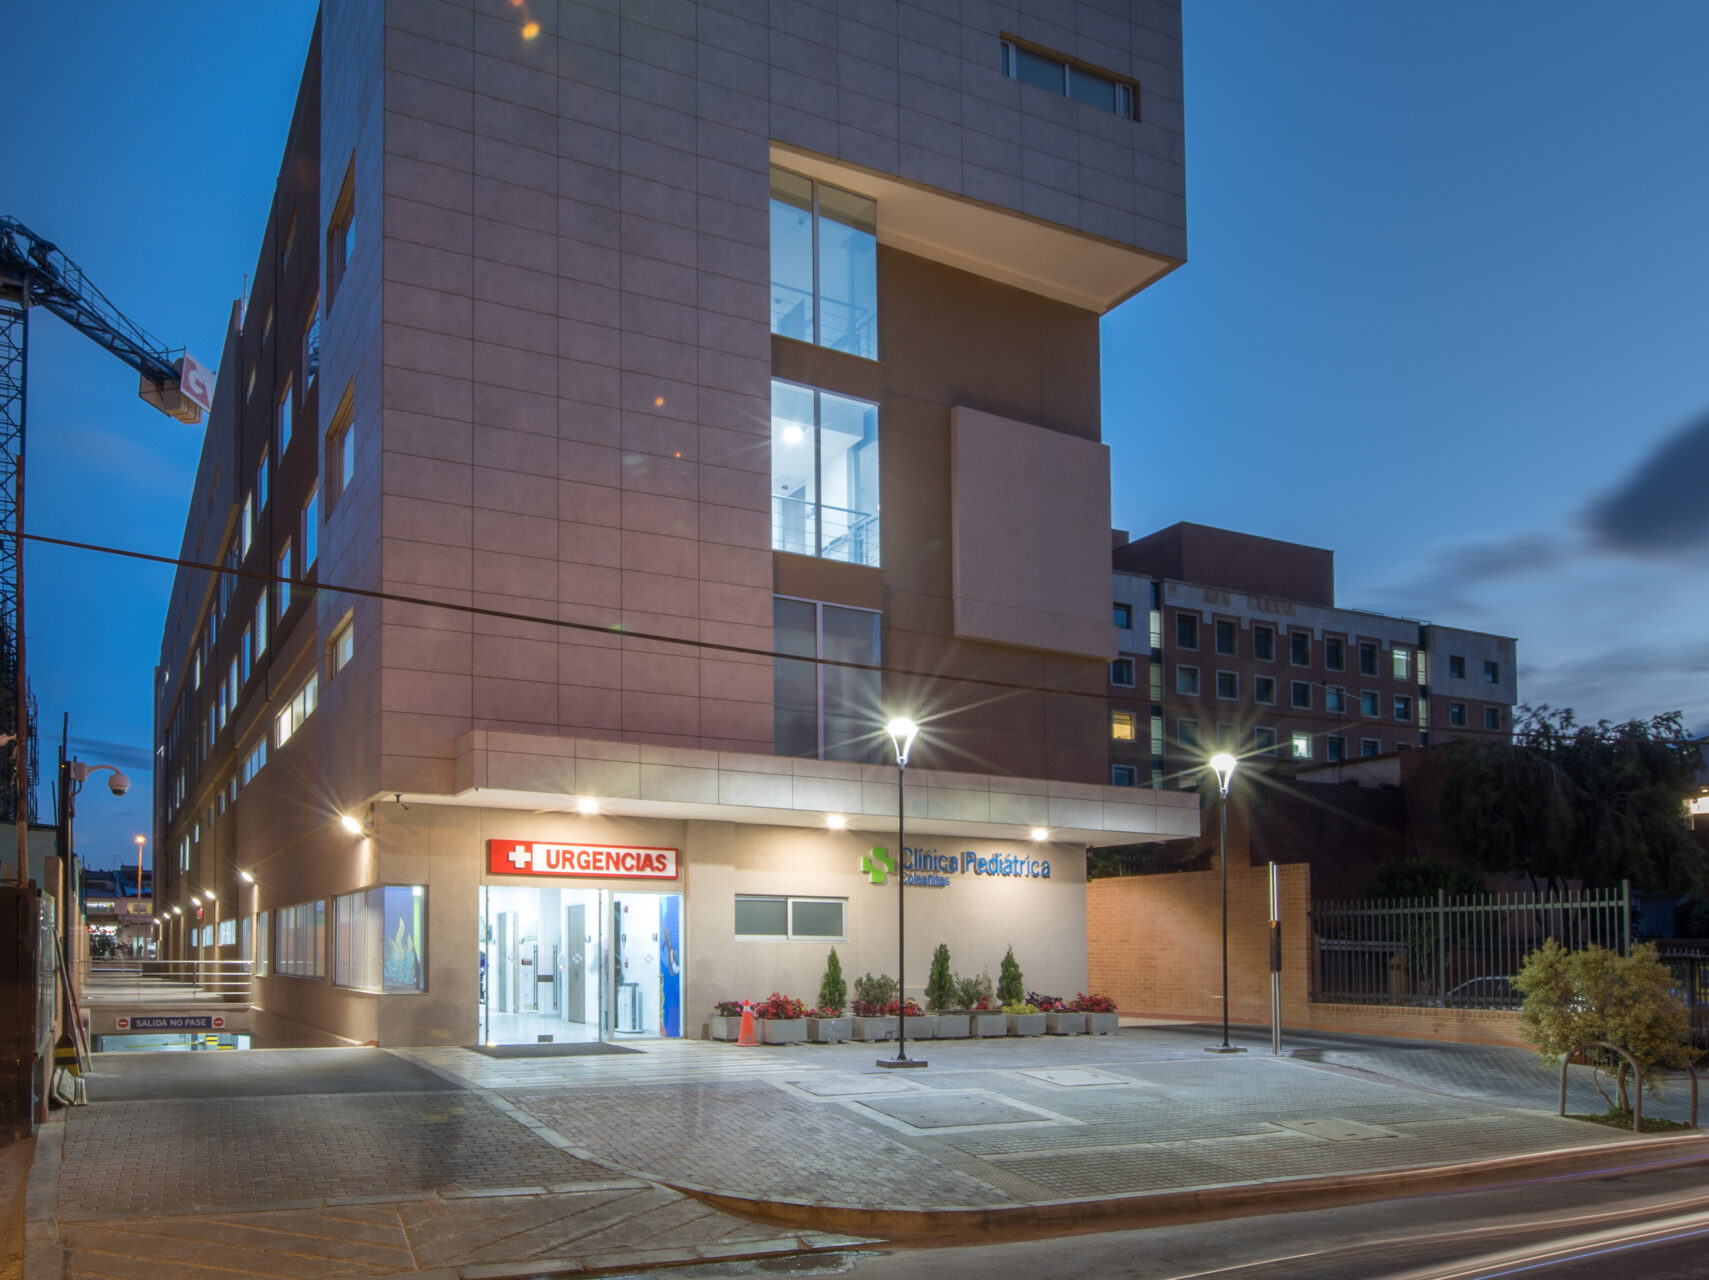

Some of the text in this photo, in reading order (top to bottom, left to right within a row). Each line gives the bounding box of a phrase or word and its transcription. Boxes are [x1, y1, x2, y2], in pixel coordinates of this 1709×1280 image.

[546, 849, 667, 872] URGENCIAS
[903, 847, 1050, 878] Clínica Pediátrica
[135, 1018, 207, 1028] SALIDA NO PASE
